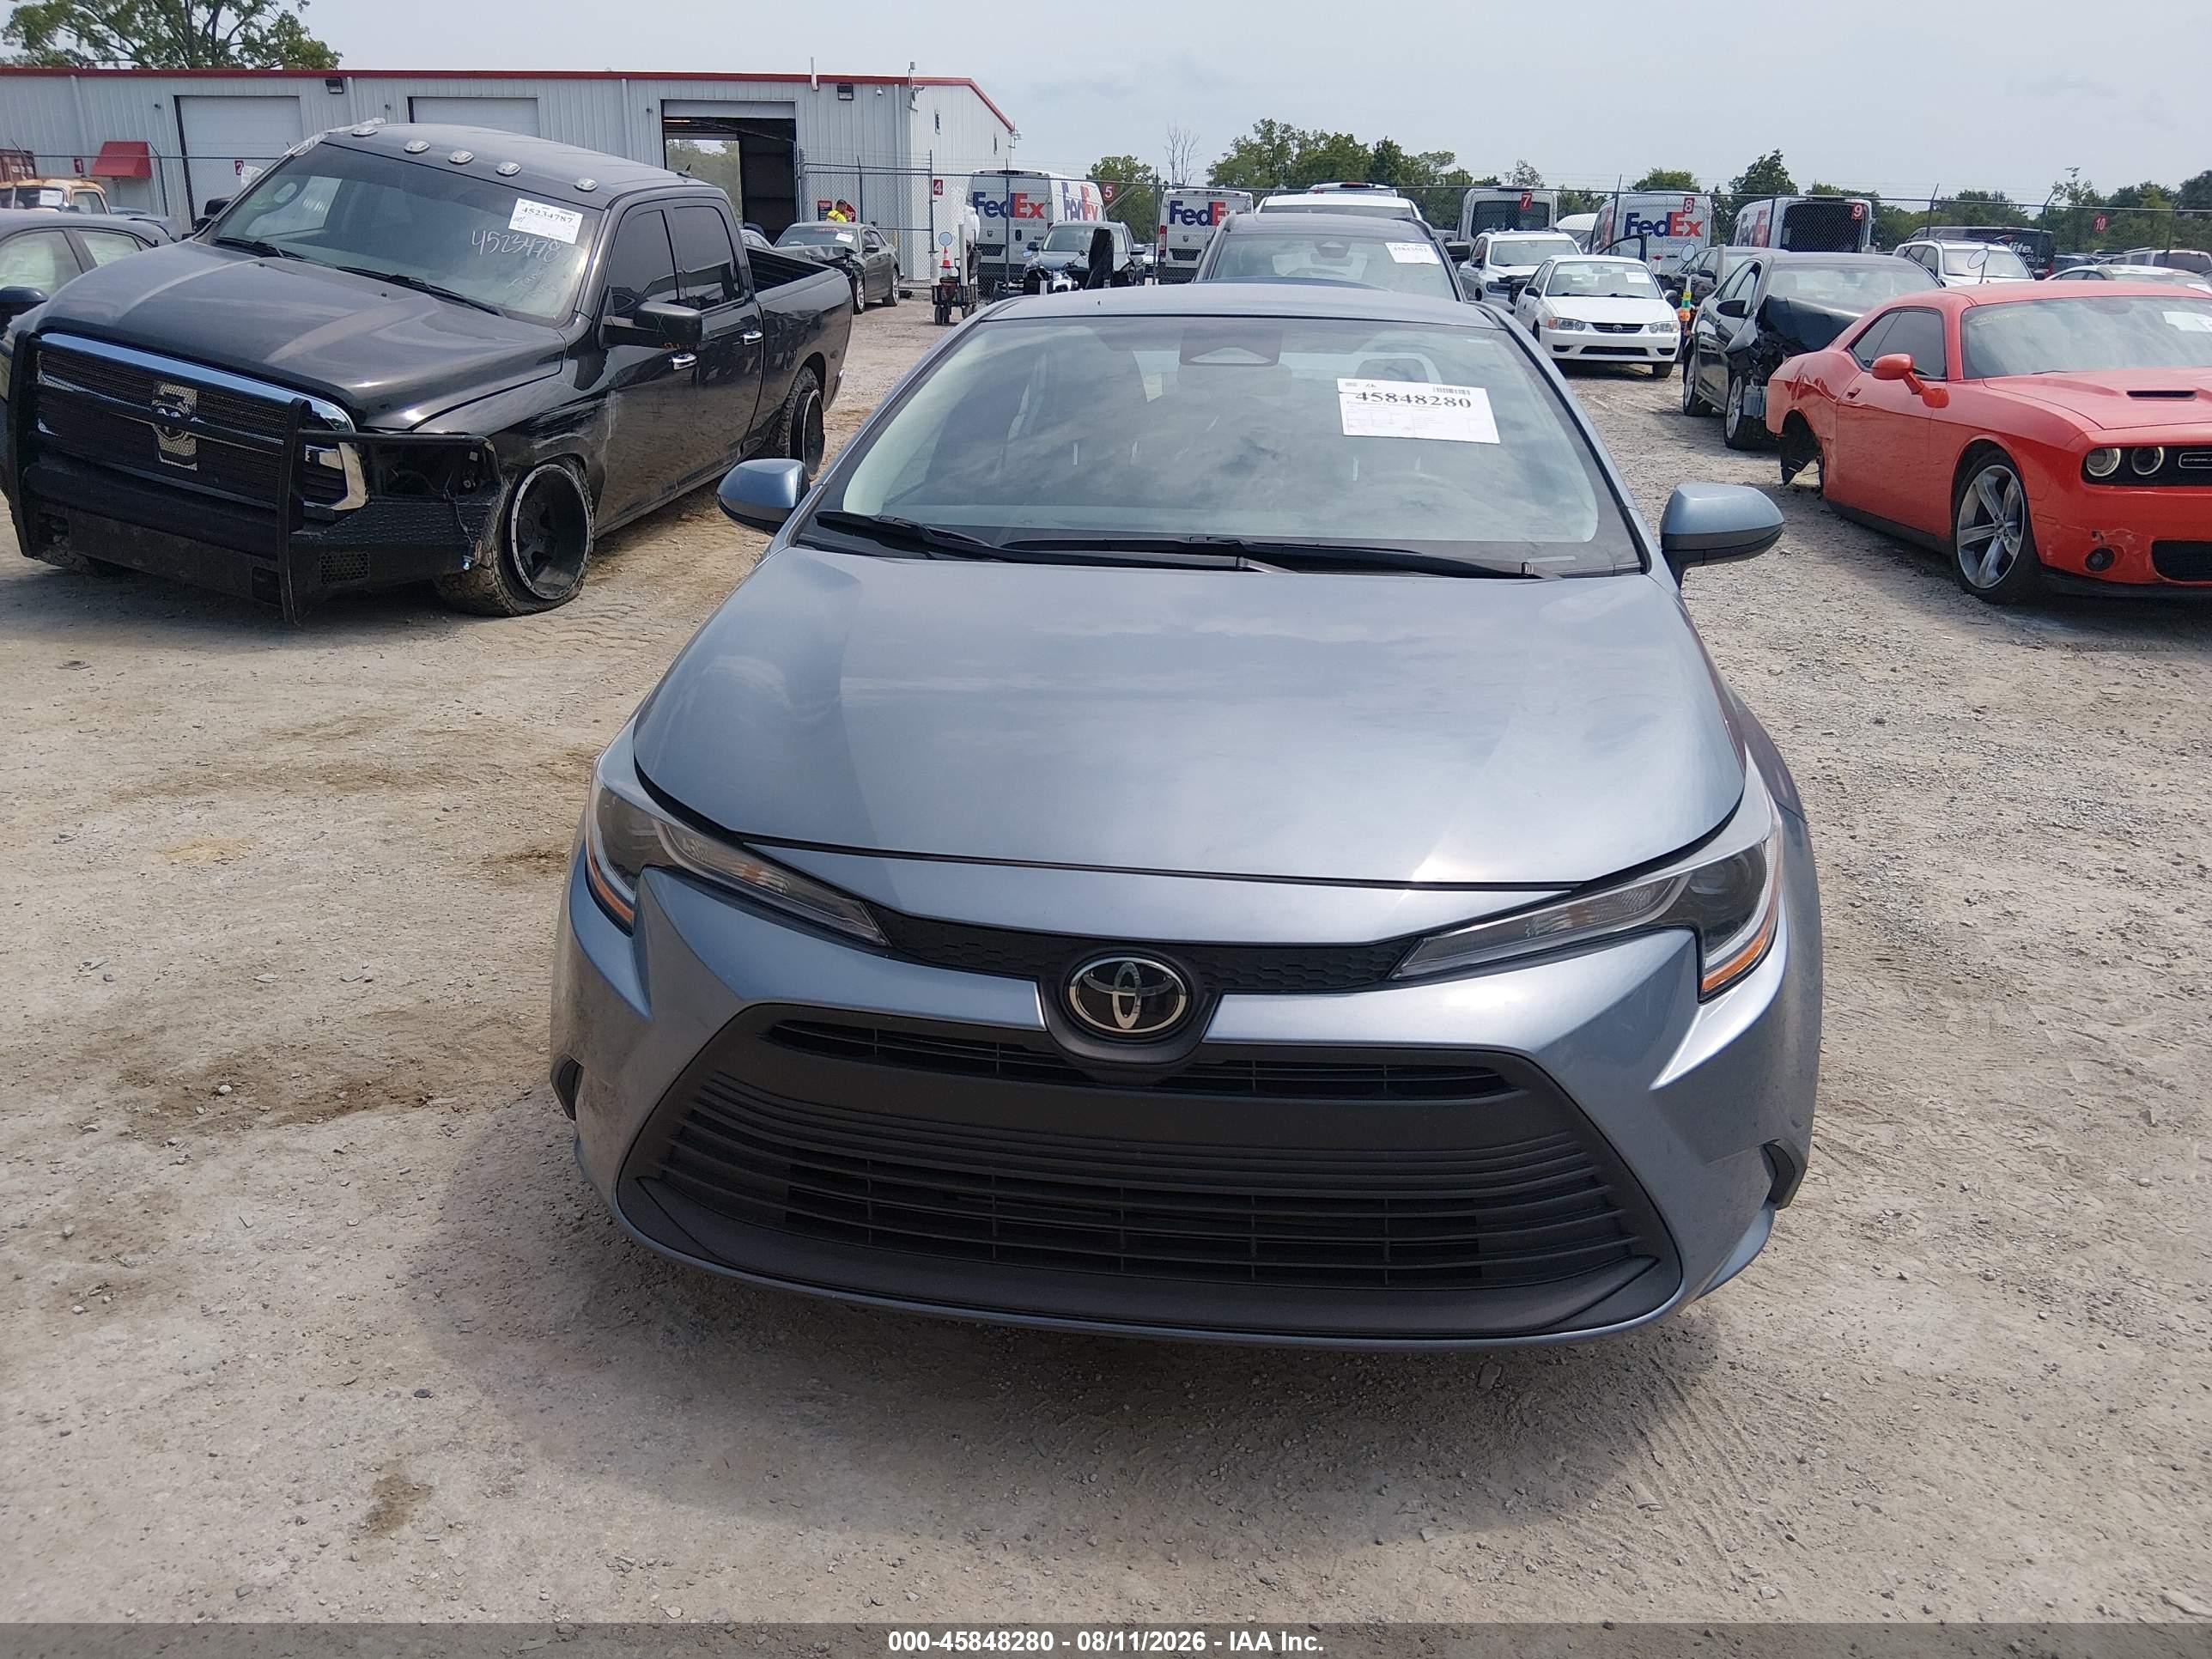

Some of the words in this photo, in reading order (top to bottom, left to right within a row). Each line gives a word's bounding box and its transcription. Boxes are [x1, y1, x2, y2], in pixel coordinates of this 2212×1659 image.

[933, 180, 943, 194] 4
[1104, 185, 1113, 198] 5
[973, 191, 1045, 219] FedEx
[1522, 194, 1531, 207] 7
[1684, 198, 1693, 212] 8
[521, 206, 574, 223] 45234787
[1169, 200, 1226, 227] FedE
[1854, 204, 1863, 217] 9
[1624, 211, 1704, 237] FedEx
[2095, 217, 2106, 230] 10
[471, 229, 561, 263] 4523478
[1355, 392, 1472, 409] 45848280
